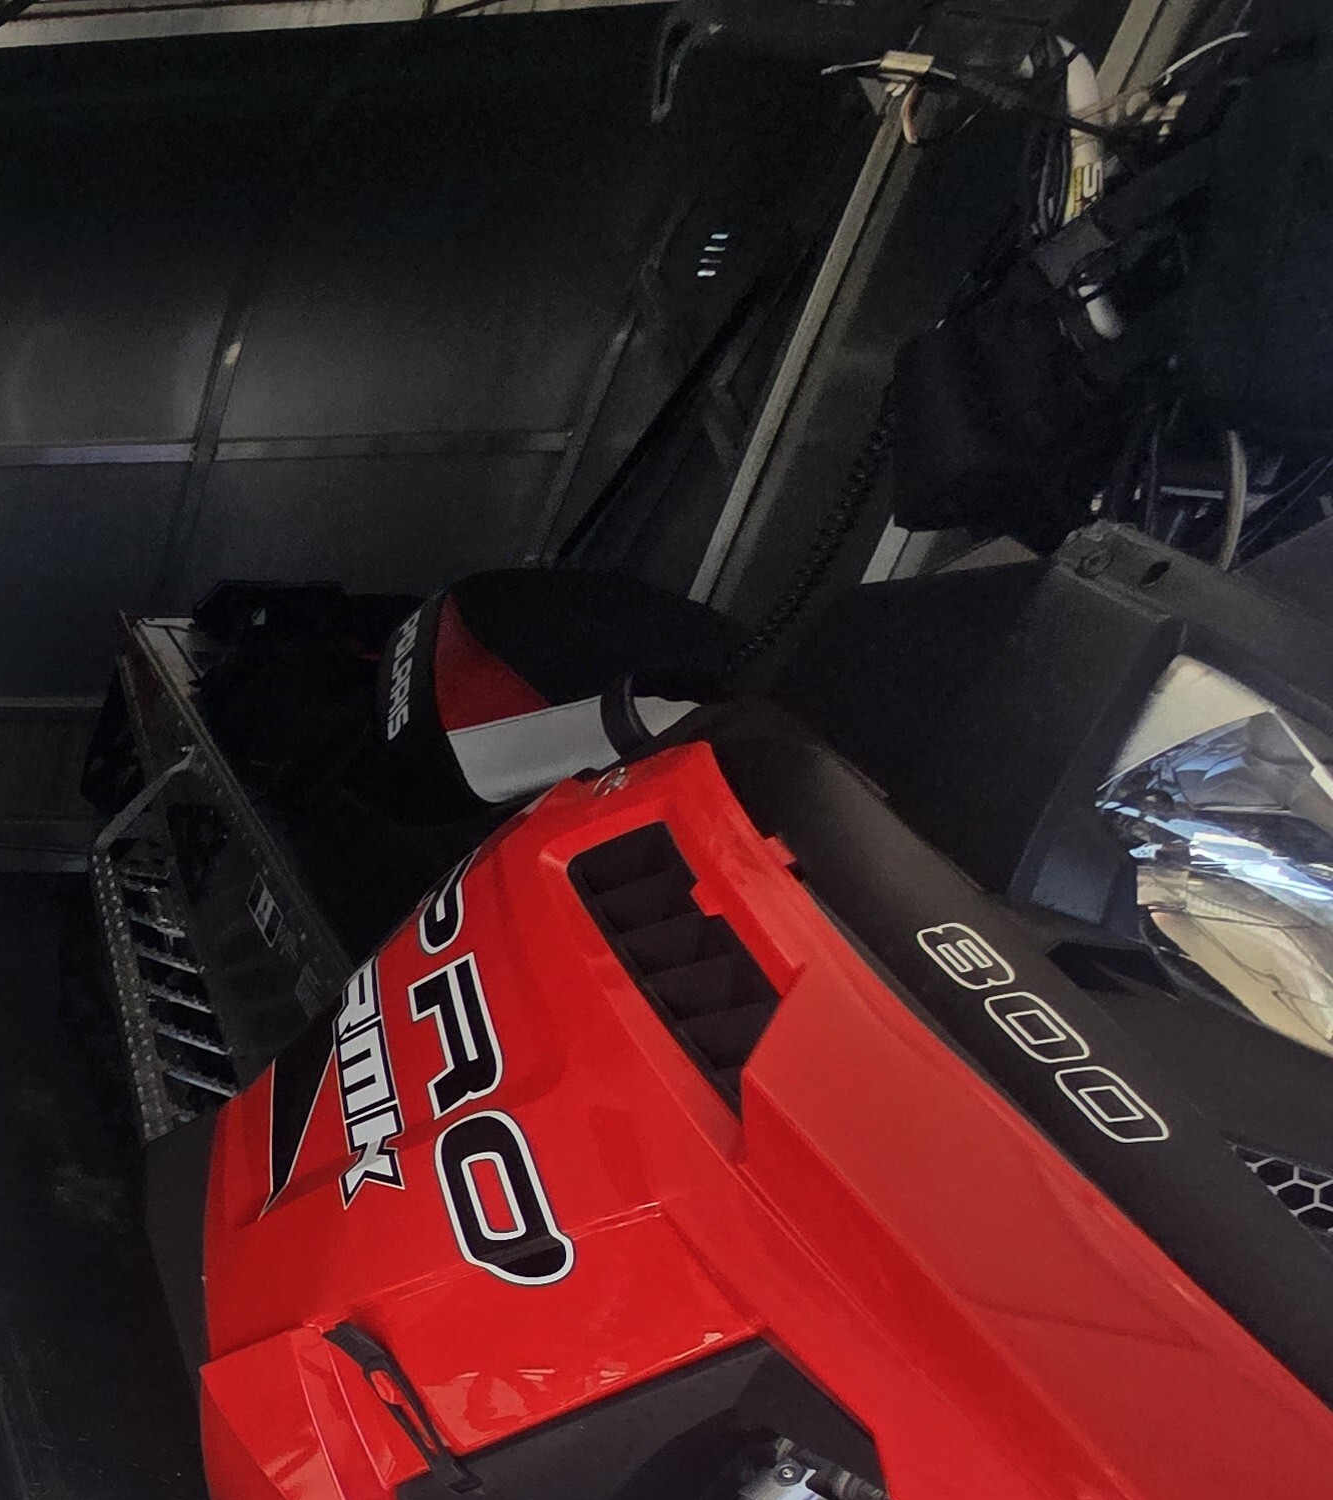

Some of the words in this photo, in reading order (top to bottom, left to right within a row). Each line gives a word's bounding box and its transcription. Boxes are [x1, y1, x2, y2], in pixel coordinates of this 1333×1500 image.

[386, 608, 422, 741] POLARIS
[407, 846, 574, 1285] PRO
[917, 922, 1170, 1144] 800
